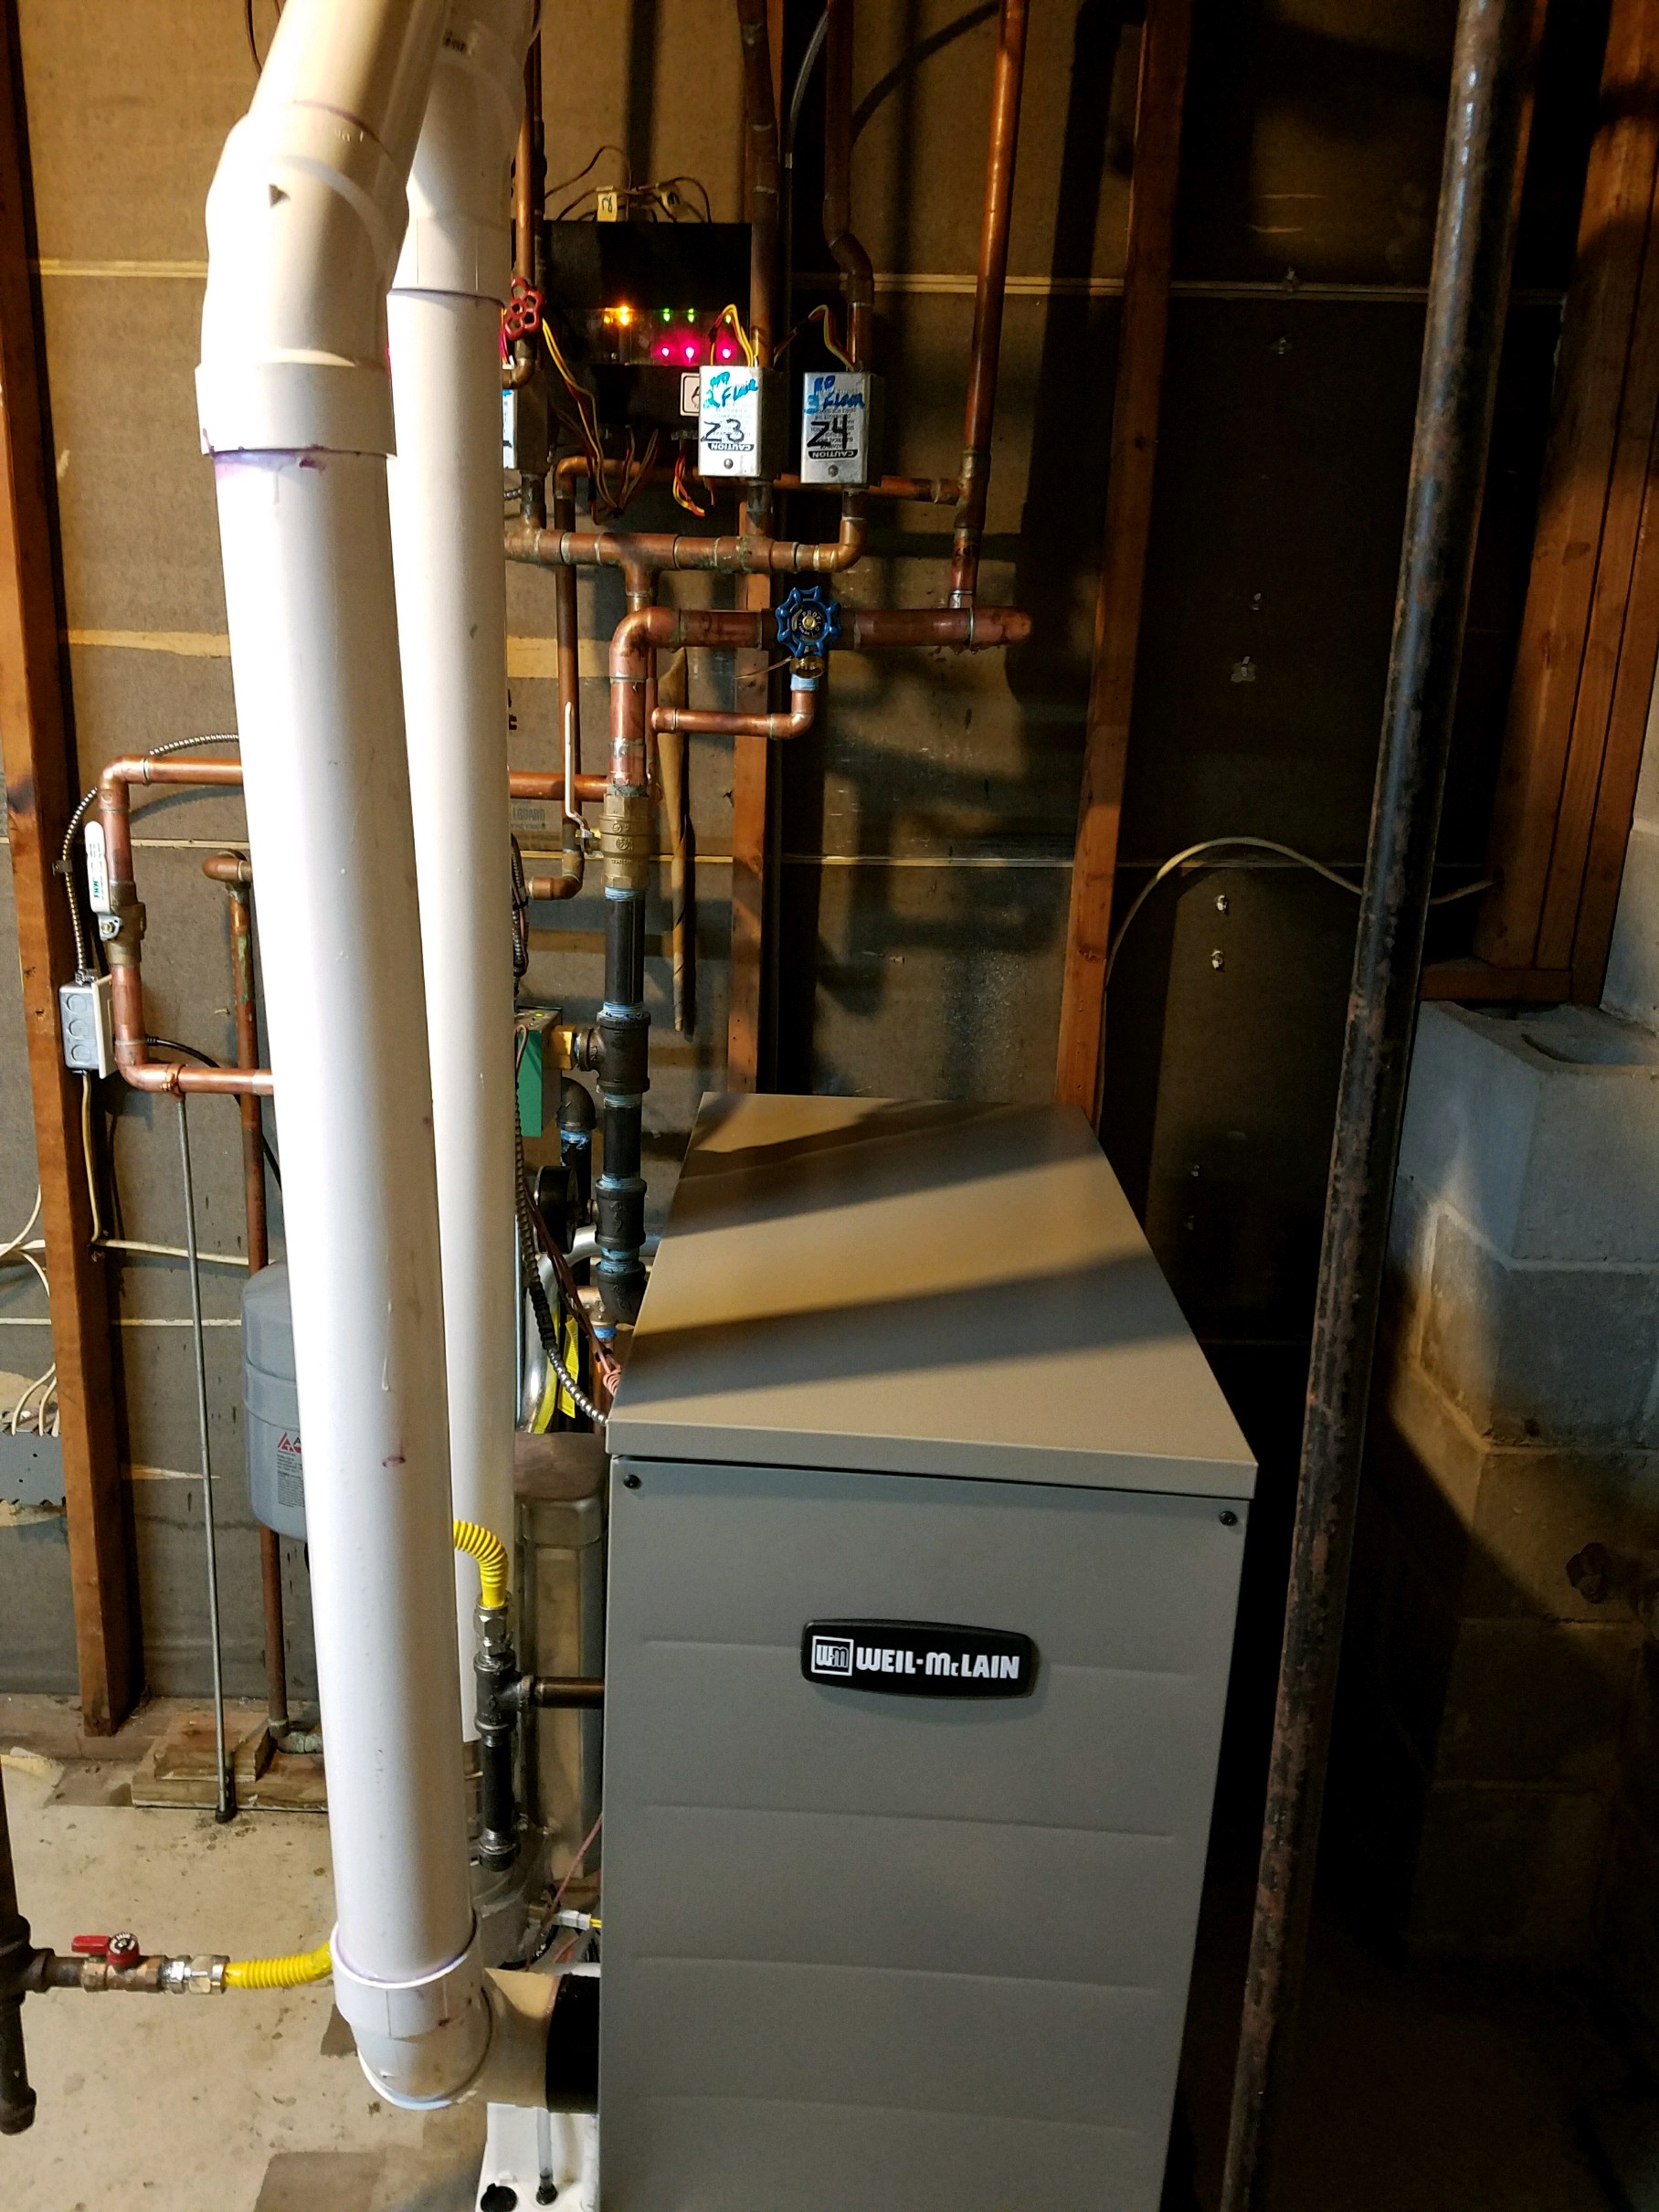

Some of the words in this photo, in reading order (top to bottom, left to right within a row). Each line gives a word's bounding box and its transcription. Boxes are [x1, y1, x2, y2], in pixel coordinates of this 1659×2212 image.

[701, 418, 745, 442] Z3
[807, 414, 849, 450] Z4
[711, 443, 751, 451] CAUTION
[812, 450, 854, 459] CAUTION
[856, 1646, 1020, 1679] WEIL-McLAIN
